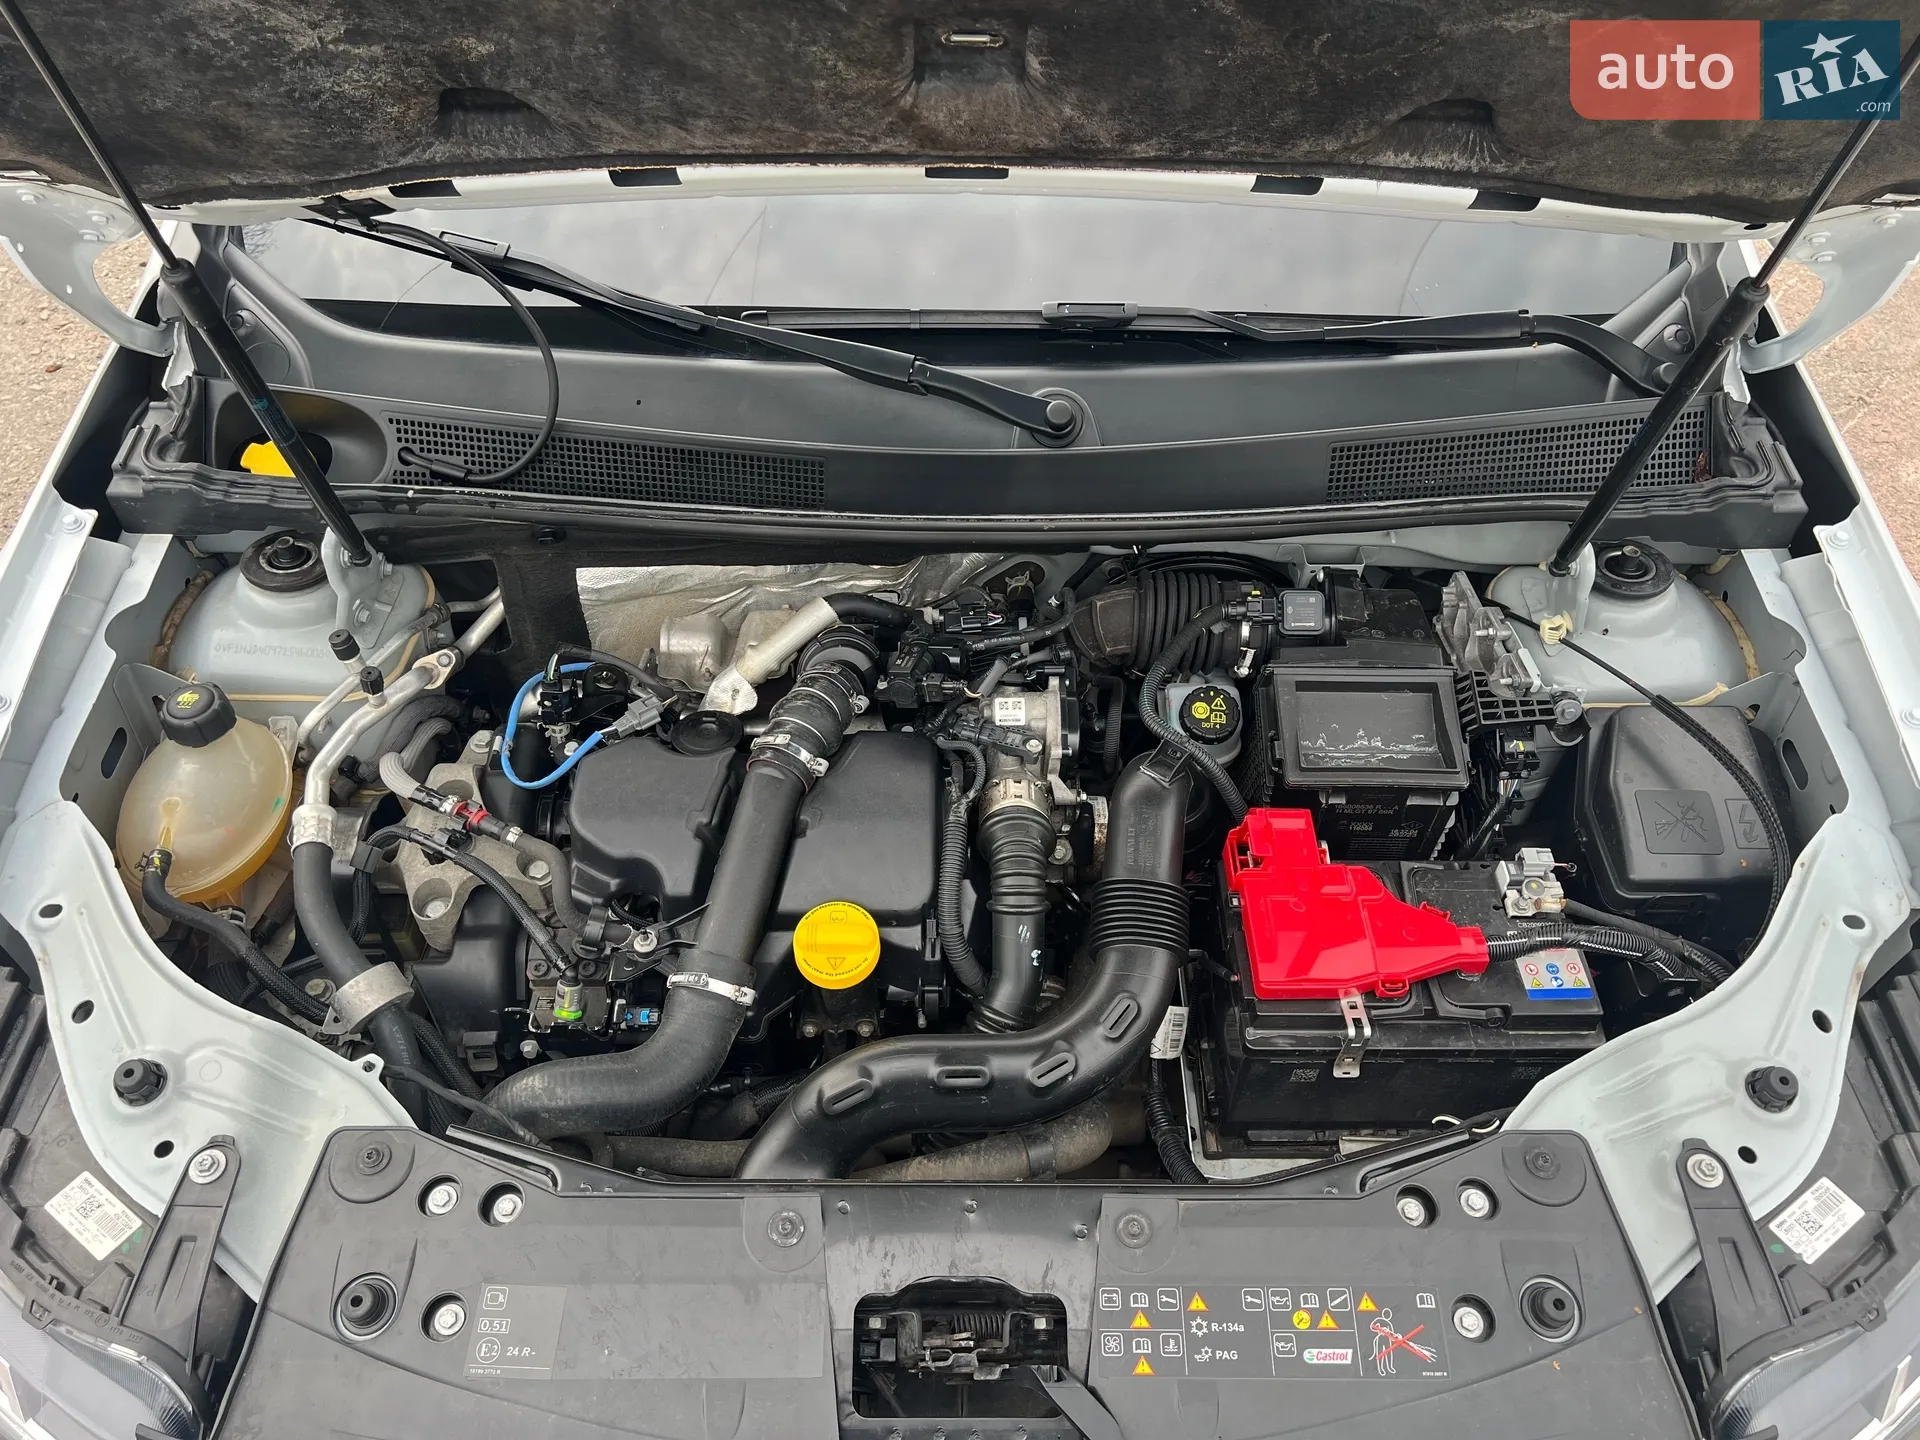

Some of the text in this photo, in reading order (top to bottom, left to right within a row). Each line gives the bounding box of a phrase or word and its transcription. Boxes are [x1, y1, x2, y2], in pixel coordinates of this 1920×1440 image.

[481, 1320, 507, 1332] 0,51
[1211, 1322, 1245, 1333] R-134a
[479, 1343, 499, 1357] E2
[506, 1346, 519, 1357] 24
[1215, 1350, 1239, 1360] PAG
[1316, 1350, 1349, 1362] Castrol
